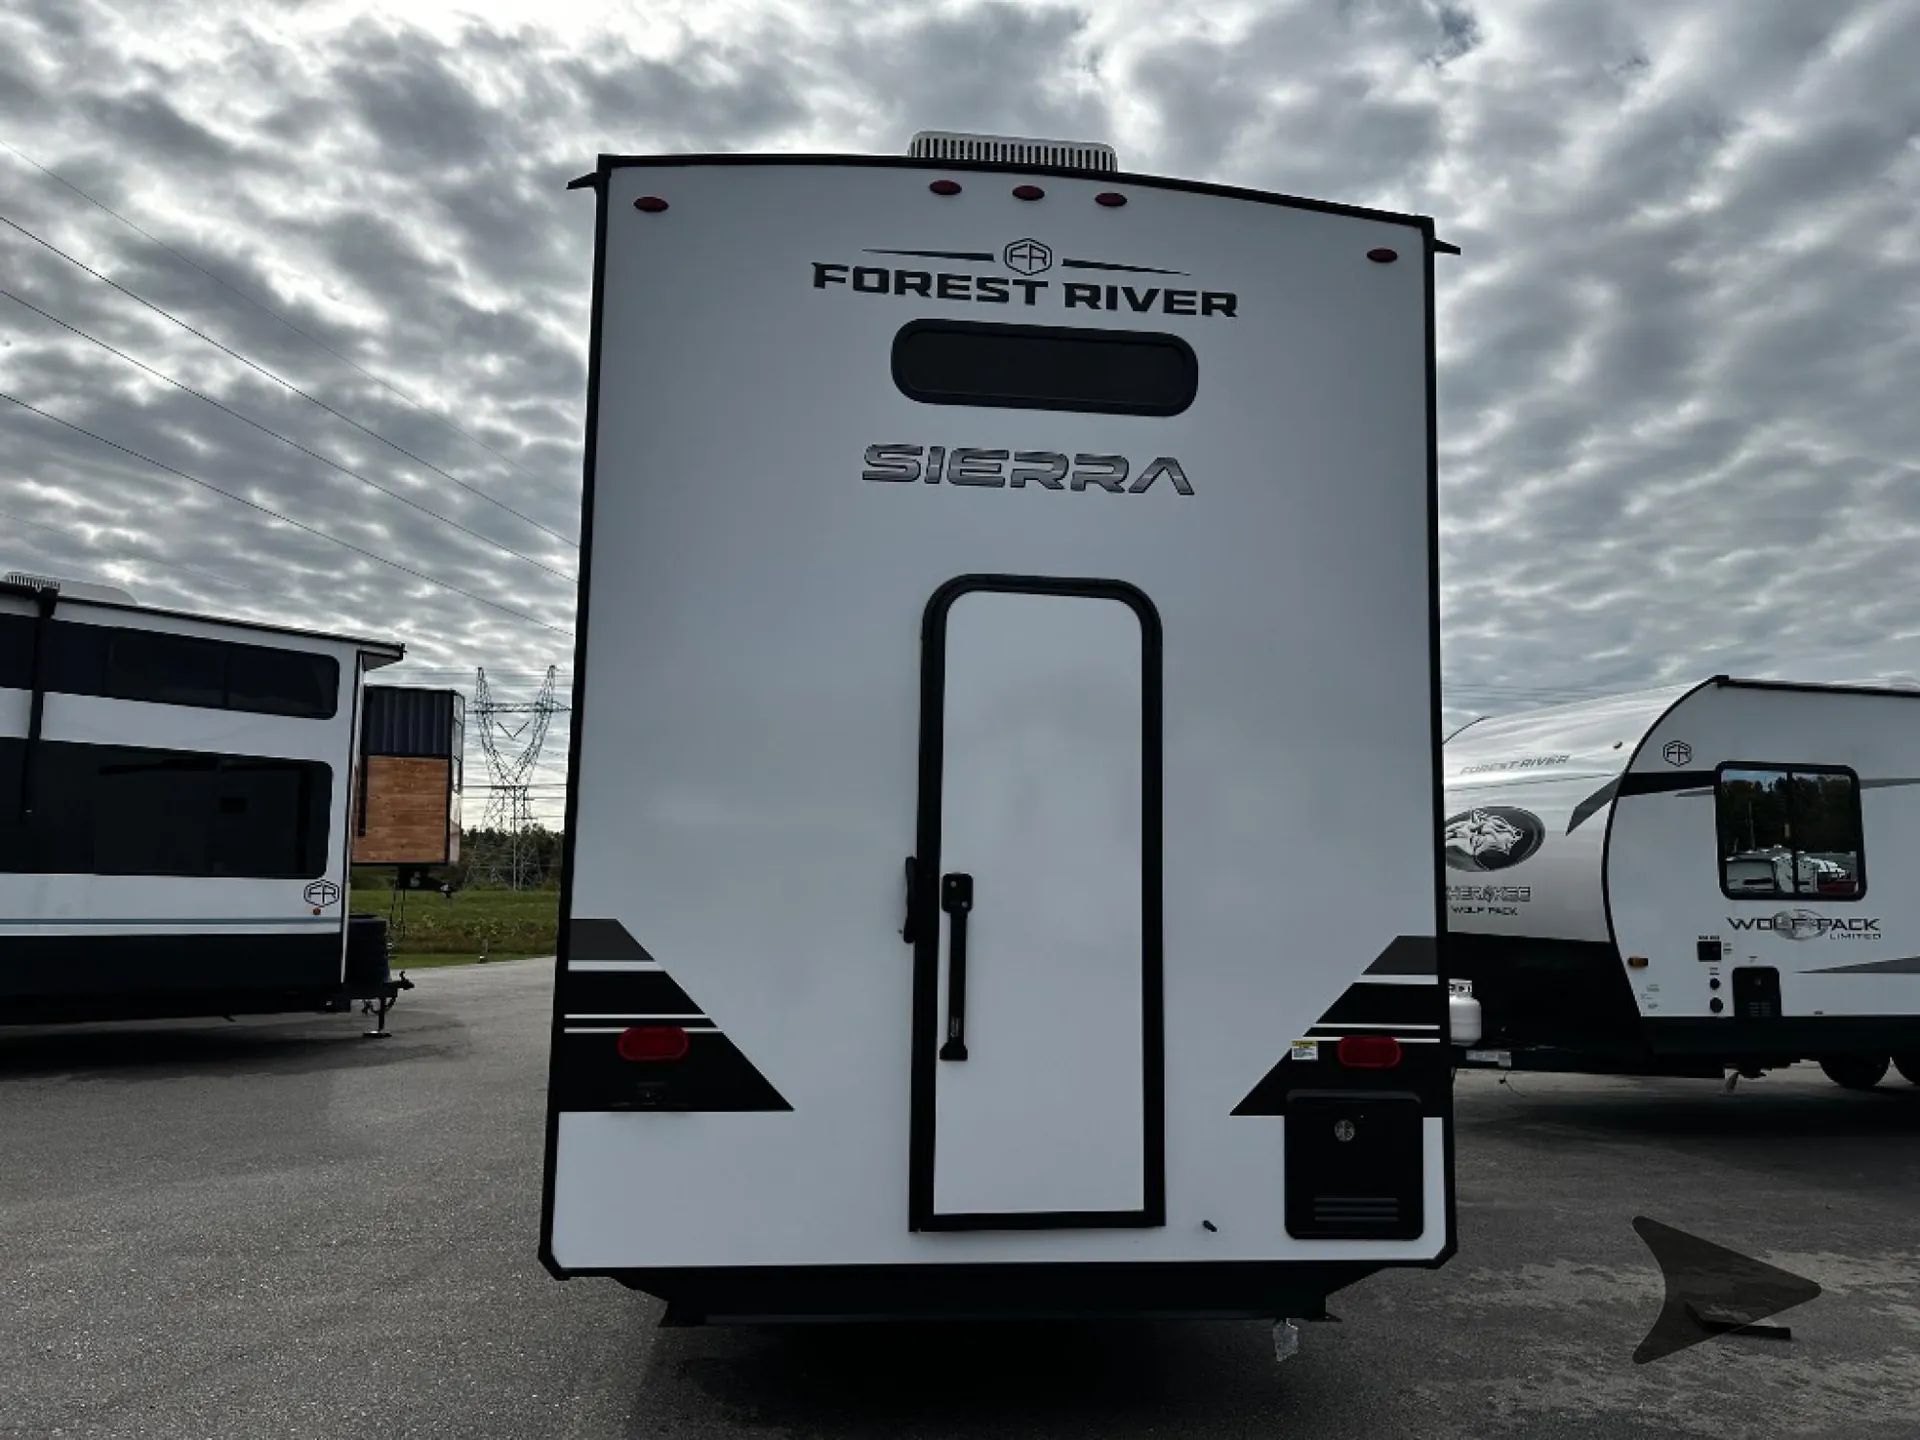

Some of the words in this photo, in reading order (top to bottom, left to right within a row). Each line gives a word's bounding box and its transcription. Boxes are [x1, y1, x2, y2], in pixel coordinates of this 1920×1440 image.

[812, 262, 1048, 305] FOREST
[1063, 282, 1238, 317] RIVER
[862, 444, 1194, 495] SIERRA
[1460, 761, 1519, 775] FOREST
[1520, 754, 1571, 768] RIVER
[1451, 905, 1485, 914] WOLF
[1488, 906, 1518, 916] PACK
[1726, 916, 1808, 931] WOLF
[1816, 918, 1881, 931] PACK
